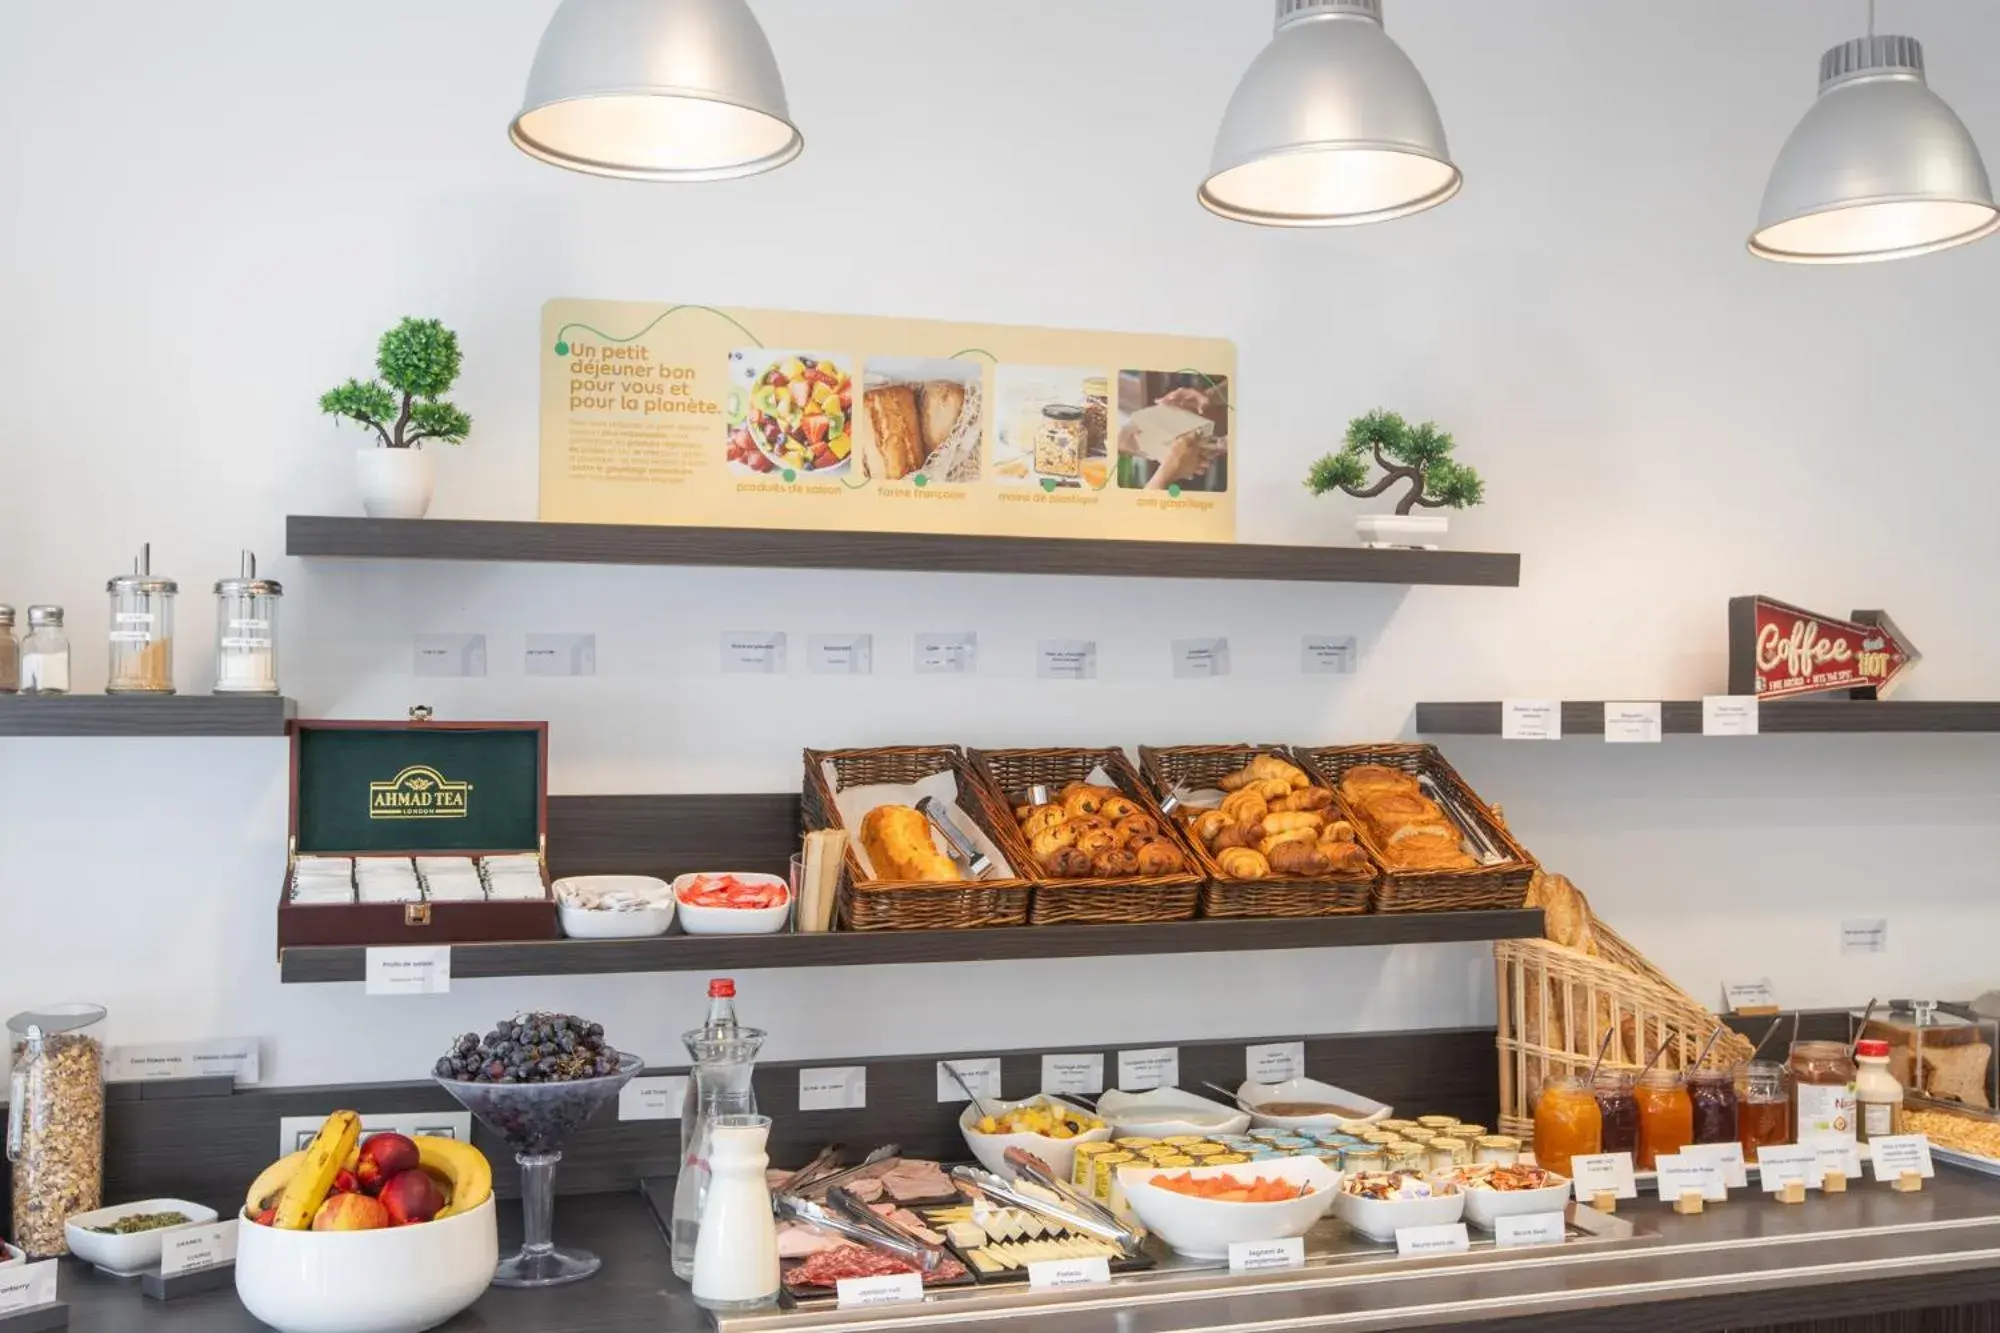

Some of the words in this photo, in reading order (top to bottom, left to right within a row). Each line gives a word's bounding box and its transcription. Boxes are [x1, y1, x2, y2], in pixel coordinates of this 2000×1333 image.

[571, 343, 596, 358] Un
[602, 345, 649, 361] petit
[570, 360, 654, 379] déjeuner
[659, 364, 695, 380] bon
[570, 379, 615, 394] pour
[622, 382, 664, 394] vous
[670, 383, 690, 396] et
[570, 396, 616, 411] pour
[621, 396, 639, 410] la
[644, 398, 722, 415] planète.
[736, 483, 785, 494] produits
[788, 484, 803, 493] de
[1757, 620, 1852, 677] Coffee
[1857, 652, 1890, 677] HOT
[374, 791, 432, 806] AHMAD
[435, 791, 463, 806] TEA
